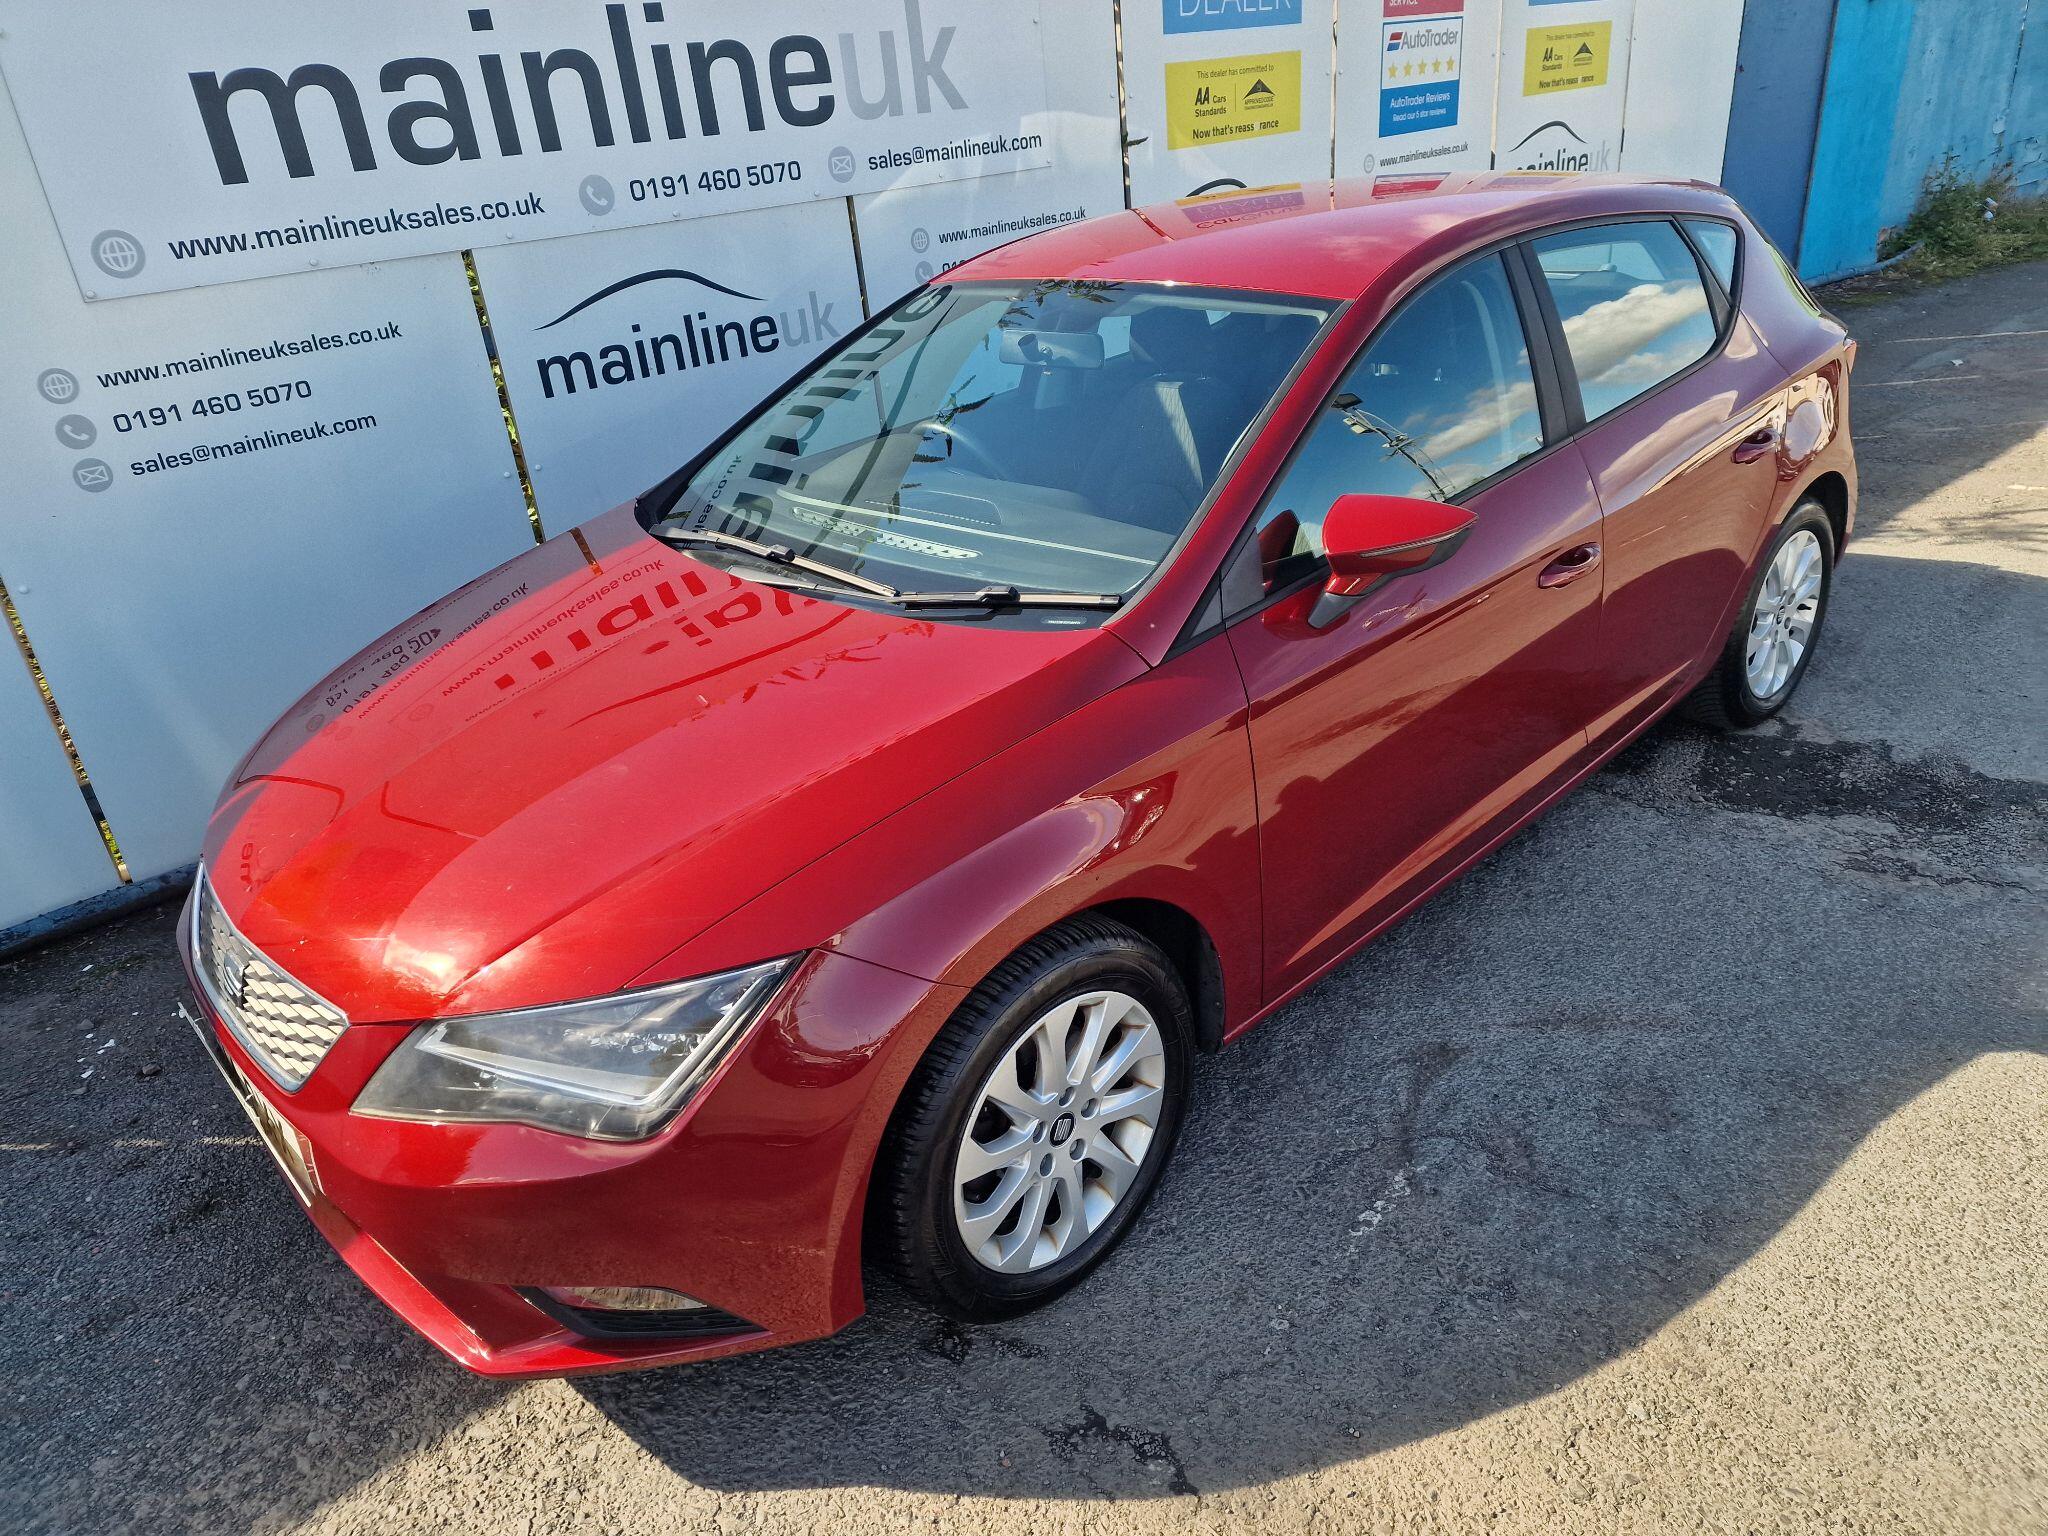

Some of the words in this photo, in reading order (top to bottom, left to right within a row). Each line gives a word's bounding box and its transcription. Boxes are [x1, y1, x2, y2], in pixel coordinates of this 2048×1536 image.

[1401, 28, 1459, 49] AutoTrader
[1197, 70, 1209, 79] This
[1210, 69, 1227, 78] dealer
[1229, 68, 1238, 76] has
[1239, 65, 1267, 75] committed
[1268, 64, 1274, 72] to
[1539, 79, 1550, 89] Now
[189, 0, 968, 185] mainlineuk
[1195, 87, 1210, 106] AA
[1212, 95, 1227, 104] Cars
[1195, 105, 1227, 118] Standards
[1390, 95, 1425, 108] AutoTrader
[1426, 92, 1451, 103] Reviews
[1192, 129, 1211, 140] Now
[1212, 124, 1234, 137] that's
[868, 133, 1042, 171] sales@mainlineuk.com
[1379, 141, 1469, 167] www.mainlineuksales.co.uk
[629, 174, 689, 201] 0191
[698, 168, 741, 193] 460
[747, 160, 801, 186] 5070
[168, 191, 545, 261] www.mainlineuksales.co.uk
[938, 206, 1086, 244] www.mainlineuksales.co.uk
[97, 321, 402, 389] www.mainlineuksales.co.uk
[537, 291, 841, 398] mainlineuk
[113, 404, 181, 433] 0191
[191, 393, 241, 418] 460
[247, 379, 312, 406] 5070
[130, 411, 377, 477] sales@mainlineuk.com
